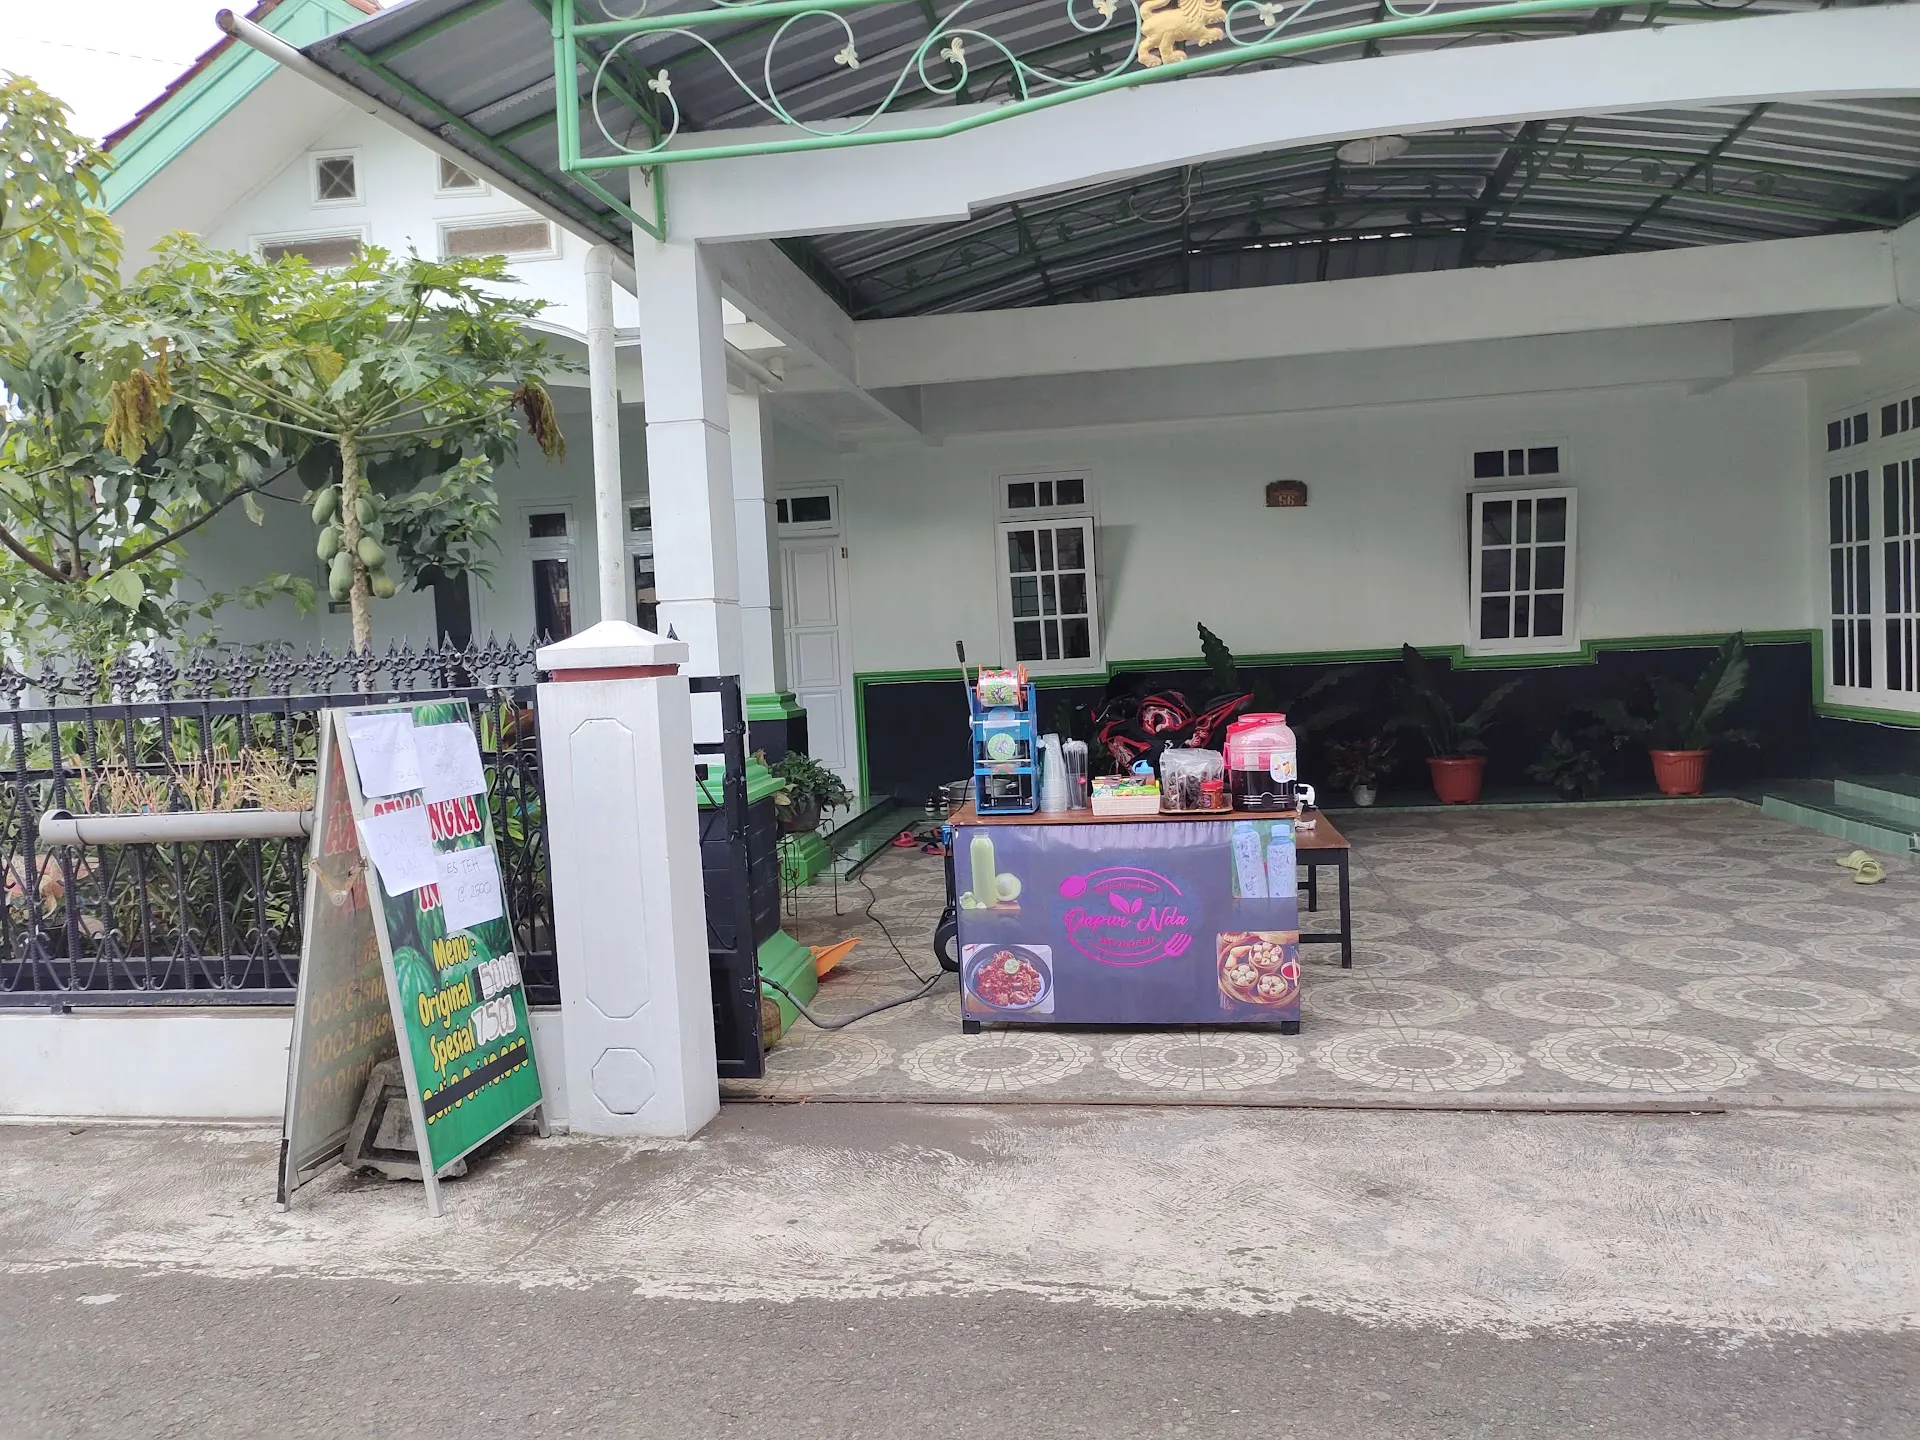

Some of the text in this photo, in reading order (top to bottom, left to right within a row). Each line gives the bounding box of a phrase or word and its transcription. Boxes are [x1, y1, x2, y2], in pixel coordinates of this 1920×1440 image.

[446, 856, 481, 874] ES TEH
[470, 881, 492, 898] 2500
[1063, 906, 1188, 932] Dapur Nda
[432, 935, 470, 972] Menu
[418, 952, 521, 1029] Original 5000
[430, 1018, 476, 1078] Spesial
